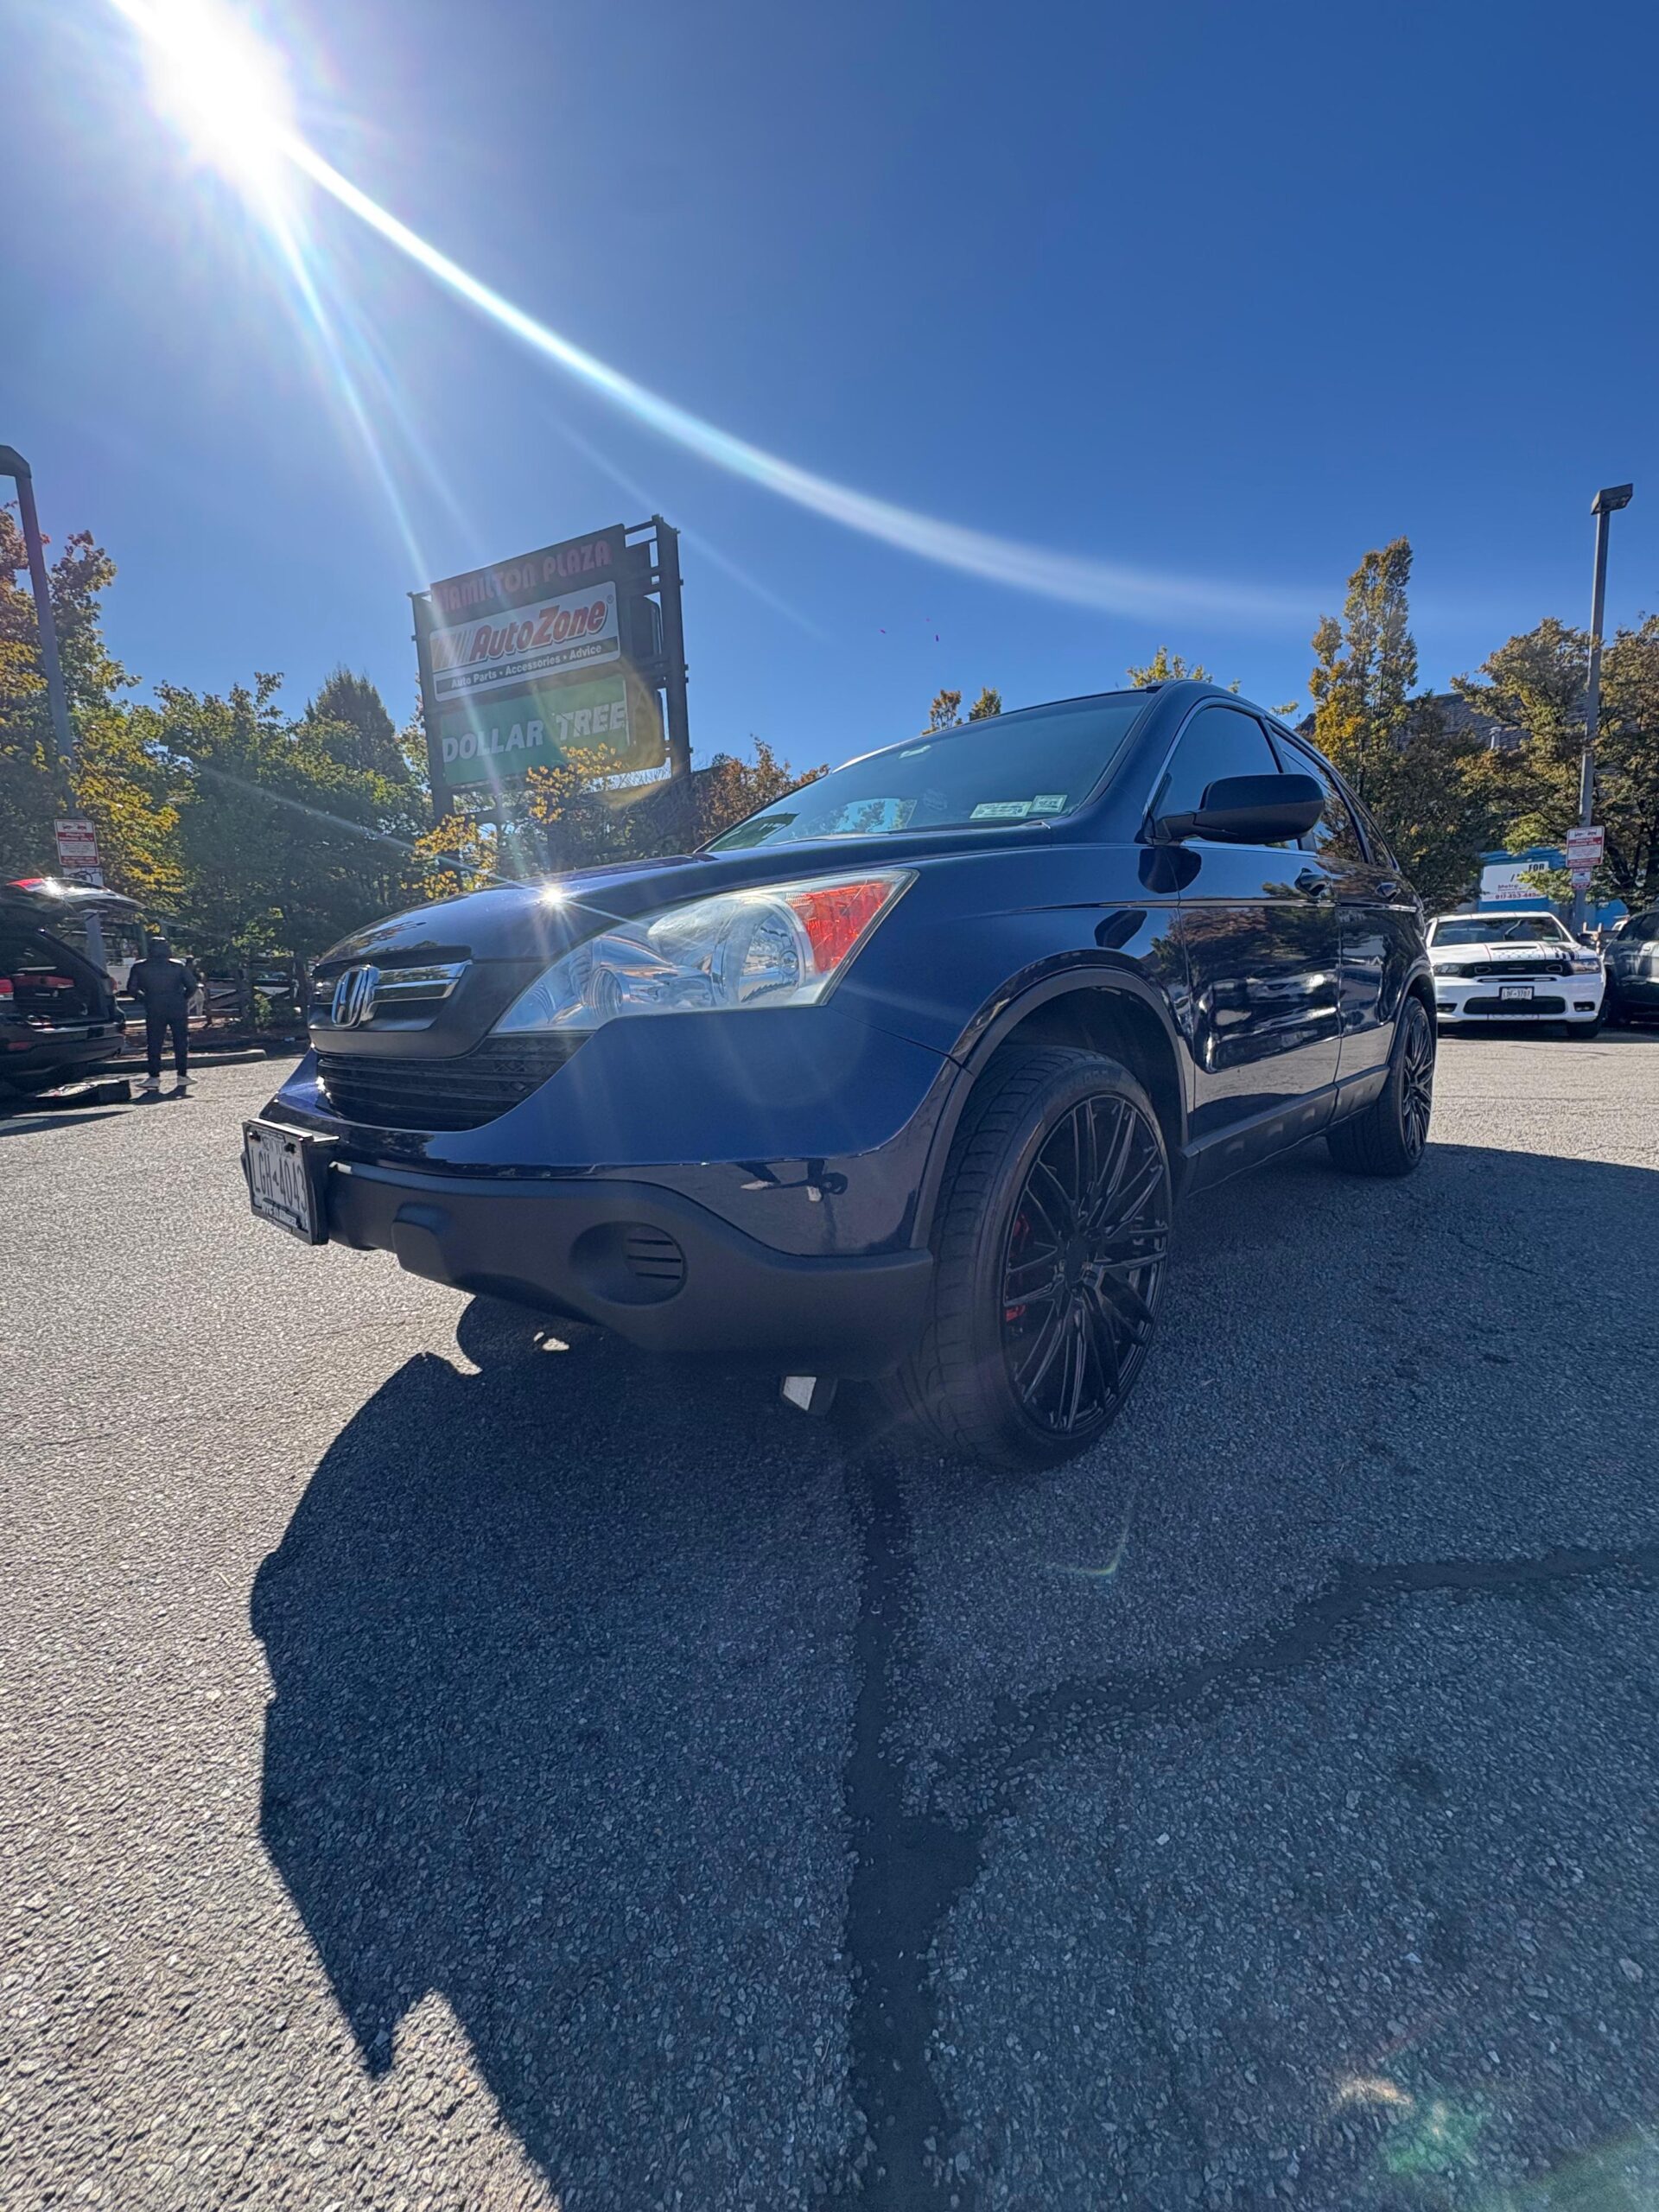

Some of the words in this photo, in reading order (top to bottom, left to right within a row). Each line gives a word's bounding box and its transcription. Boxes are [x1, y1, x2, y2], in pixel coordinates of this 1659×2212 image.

[438, 563, 537, 613] HAMILTON
[543, 539, 613, 583] PLAZA
[469, 601, 608, 663] AutoZone
[451, 675, 471, 689] Auto
[474, 669, 498, 683] Parts
[505, 654, 561, 677] Accessories
[569, 644, 602, 660] Advice
[442, 719, 544, 764] DOLLAR
[556, 701, 626, 741] TREE
[1528, 863, 1545, 872] FOR
[251, 1149, 274, 1198] LGH
[279, 1156, 308, 1213] 4043
